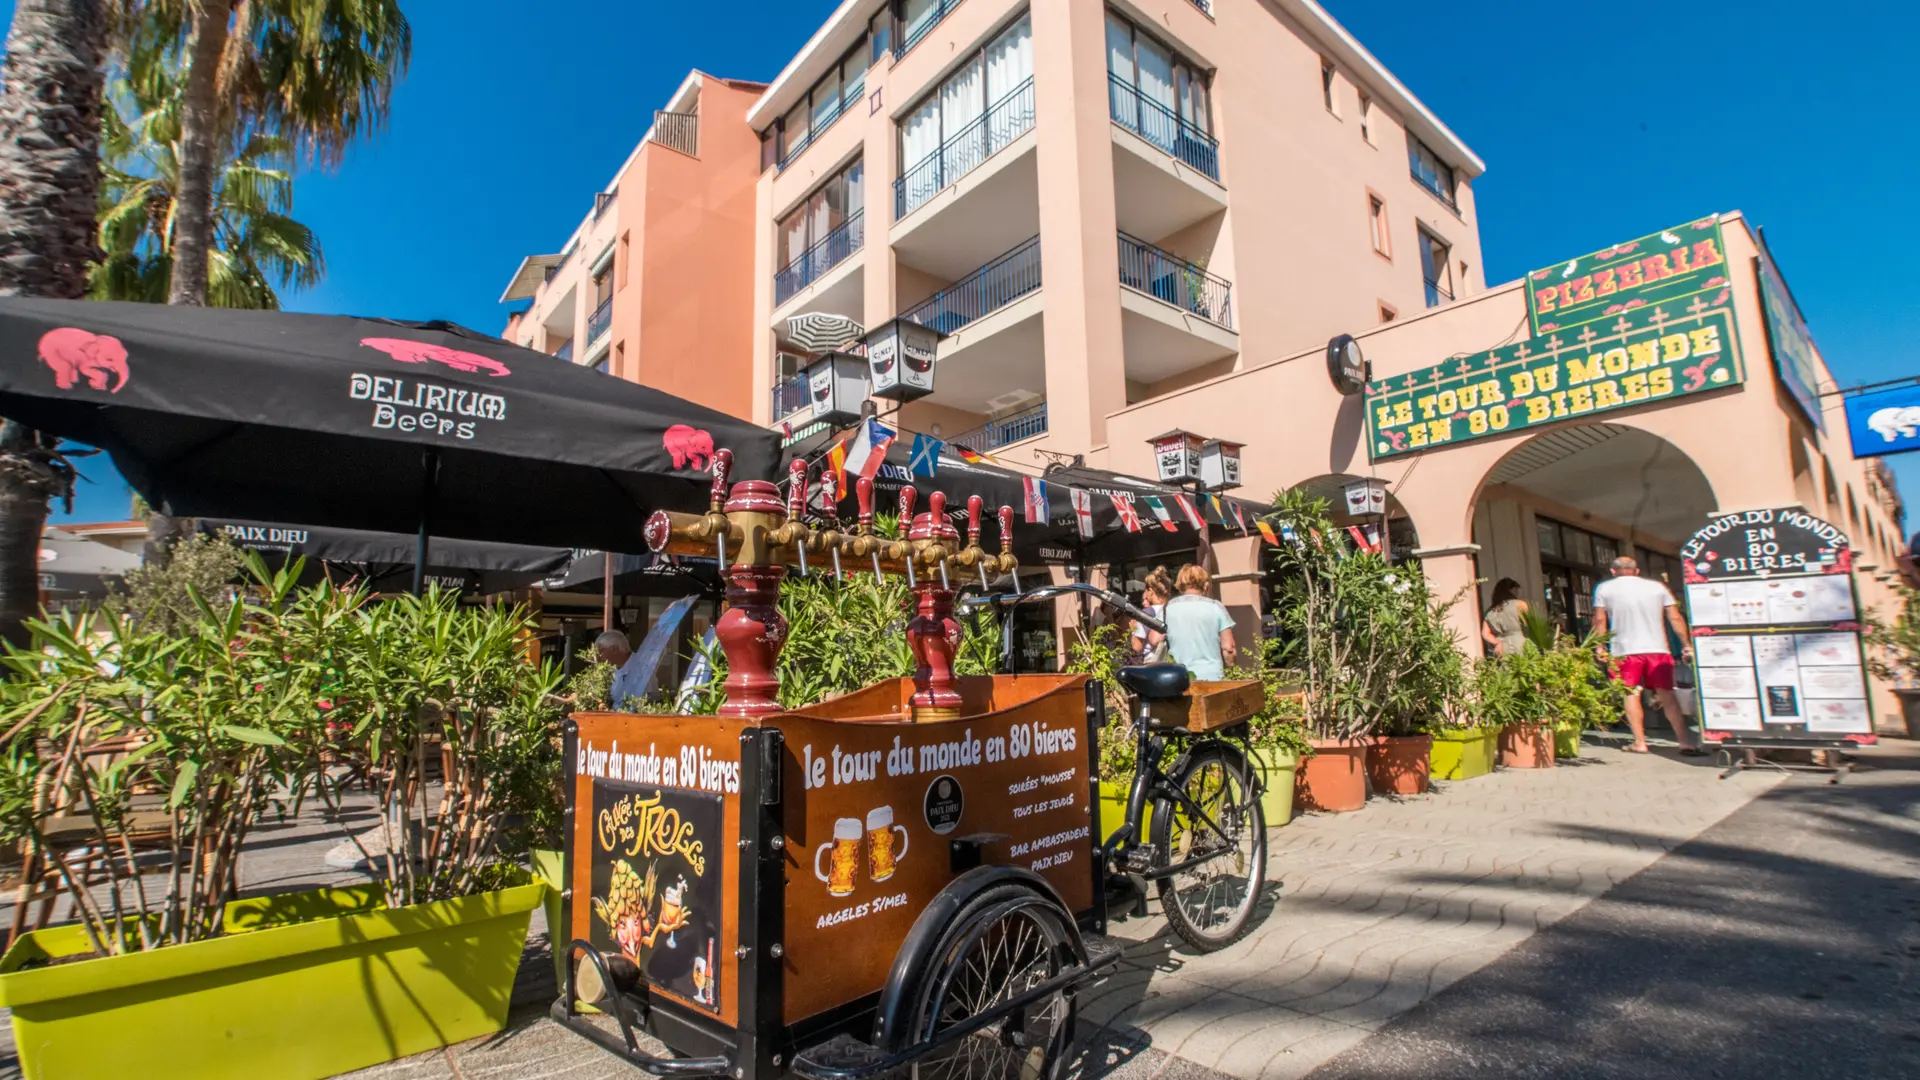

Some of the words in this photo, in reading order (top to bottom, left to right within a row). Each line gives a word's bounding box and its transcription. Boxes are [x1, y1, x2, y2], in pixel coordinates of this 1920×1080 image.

[1535, 238, 1724, 314] PIZZERIA
[1377, 402, 1414, 429] LE
[1419, 379, 1505, 420] TOUR
[1510, 364, 1558, 398] DU
[1566, 325, 1722, 385] MONDE
[350, 372, 507, 421] DELIRIUM
[1408, 416, 1452, 448] EN
[1468, 404, 1510, 435] 80
[1525, 366, 1675, 424] BIERES
[372, 403, 477, 440] Beers
[224, 524, 266, 541] PAIX
[269, 528, 309, 544] DIEU
[1682, 539, 1705, 560] LE
[1697, 513, 1745, 542] TOUR
[1745, 509, 1774, 525] DU
[1778, 510, 1849, 548] MONDE
[1745, 527, 1776, 543] EN
[1748, 542, 1780, 557] 80
[1722, 552, 1807, 572] BIERES
[576, 738, 585, 775] le
[586, 740, 608, 778] tour
[608, 740, 623, 780] du
[624, 742, 661, 785] monde
[662, 756, 677, 787] en
[680, 745, 697, 788] 80
[699, 745, 740, 794] bieres
[803, 744, 826, 790] le
[832, 744, 881, 785] tour
[887, 735, 914, 776] du
[920, 728, 981, 773] monde
[985, 736, 1005, 763] en
[1010, 723, 1031, 759] 80
[1033, 721, 1076, 756] bieres
[1013, 804, 1033, 819] TOUS
[1034, 801, 1048, 812] LES
[1049, 793, 1074, 809] JEUDIS
[1010, 842, 1029, 858] BAR
[1031, 826, 1089, 851] AMBASSADEUR
[1031, 856, 1052, 871] PAIX
[1054, 850, 1073, 865] DIEU
[816, 902, 870, 929] ARGELES
[872, 893, 907, 913] S/MER
